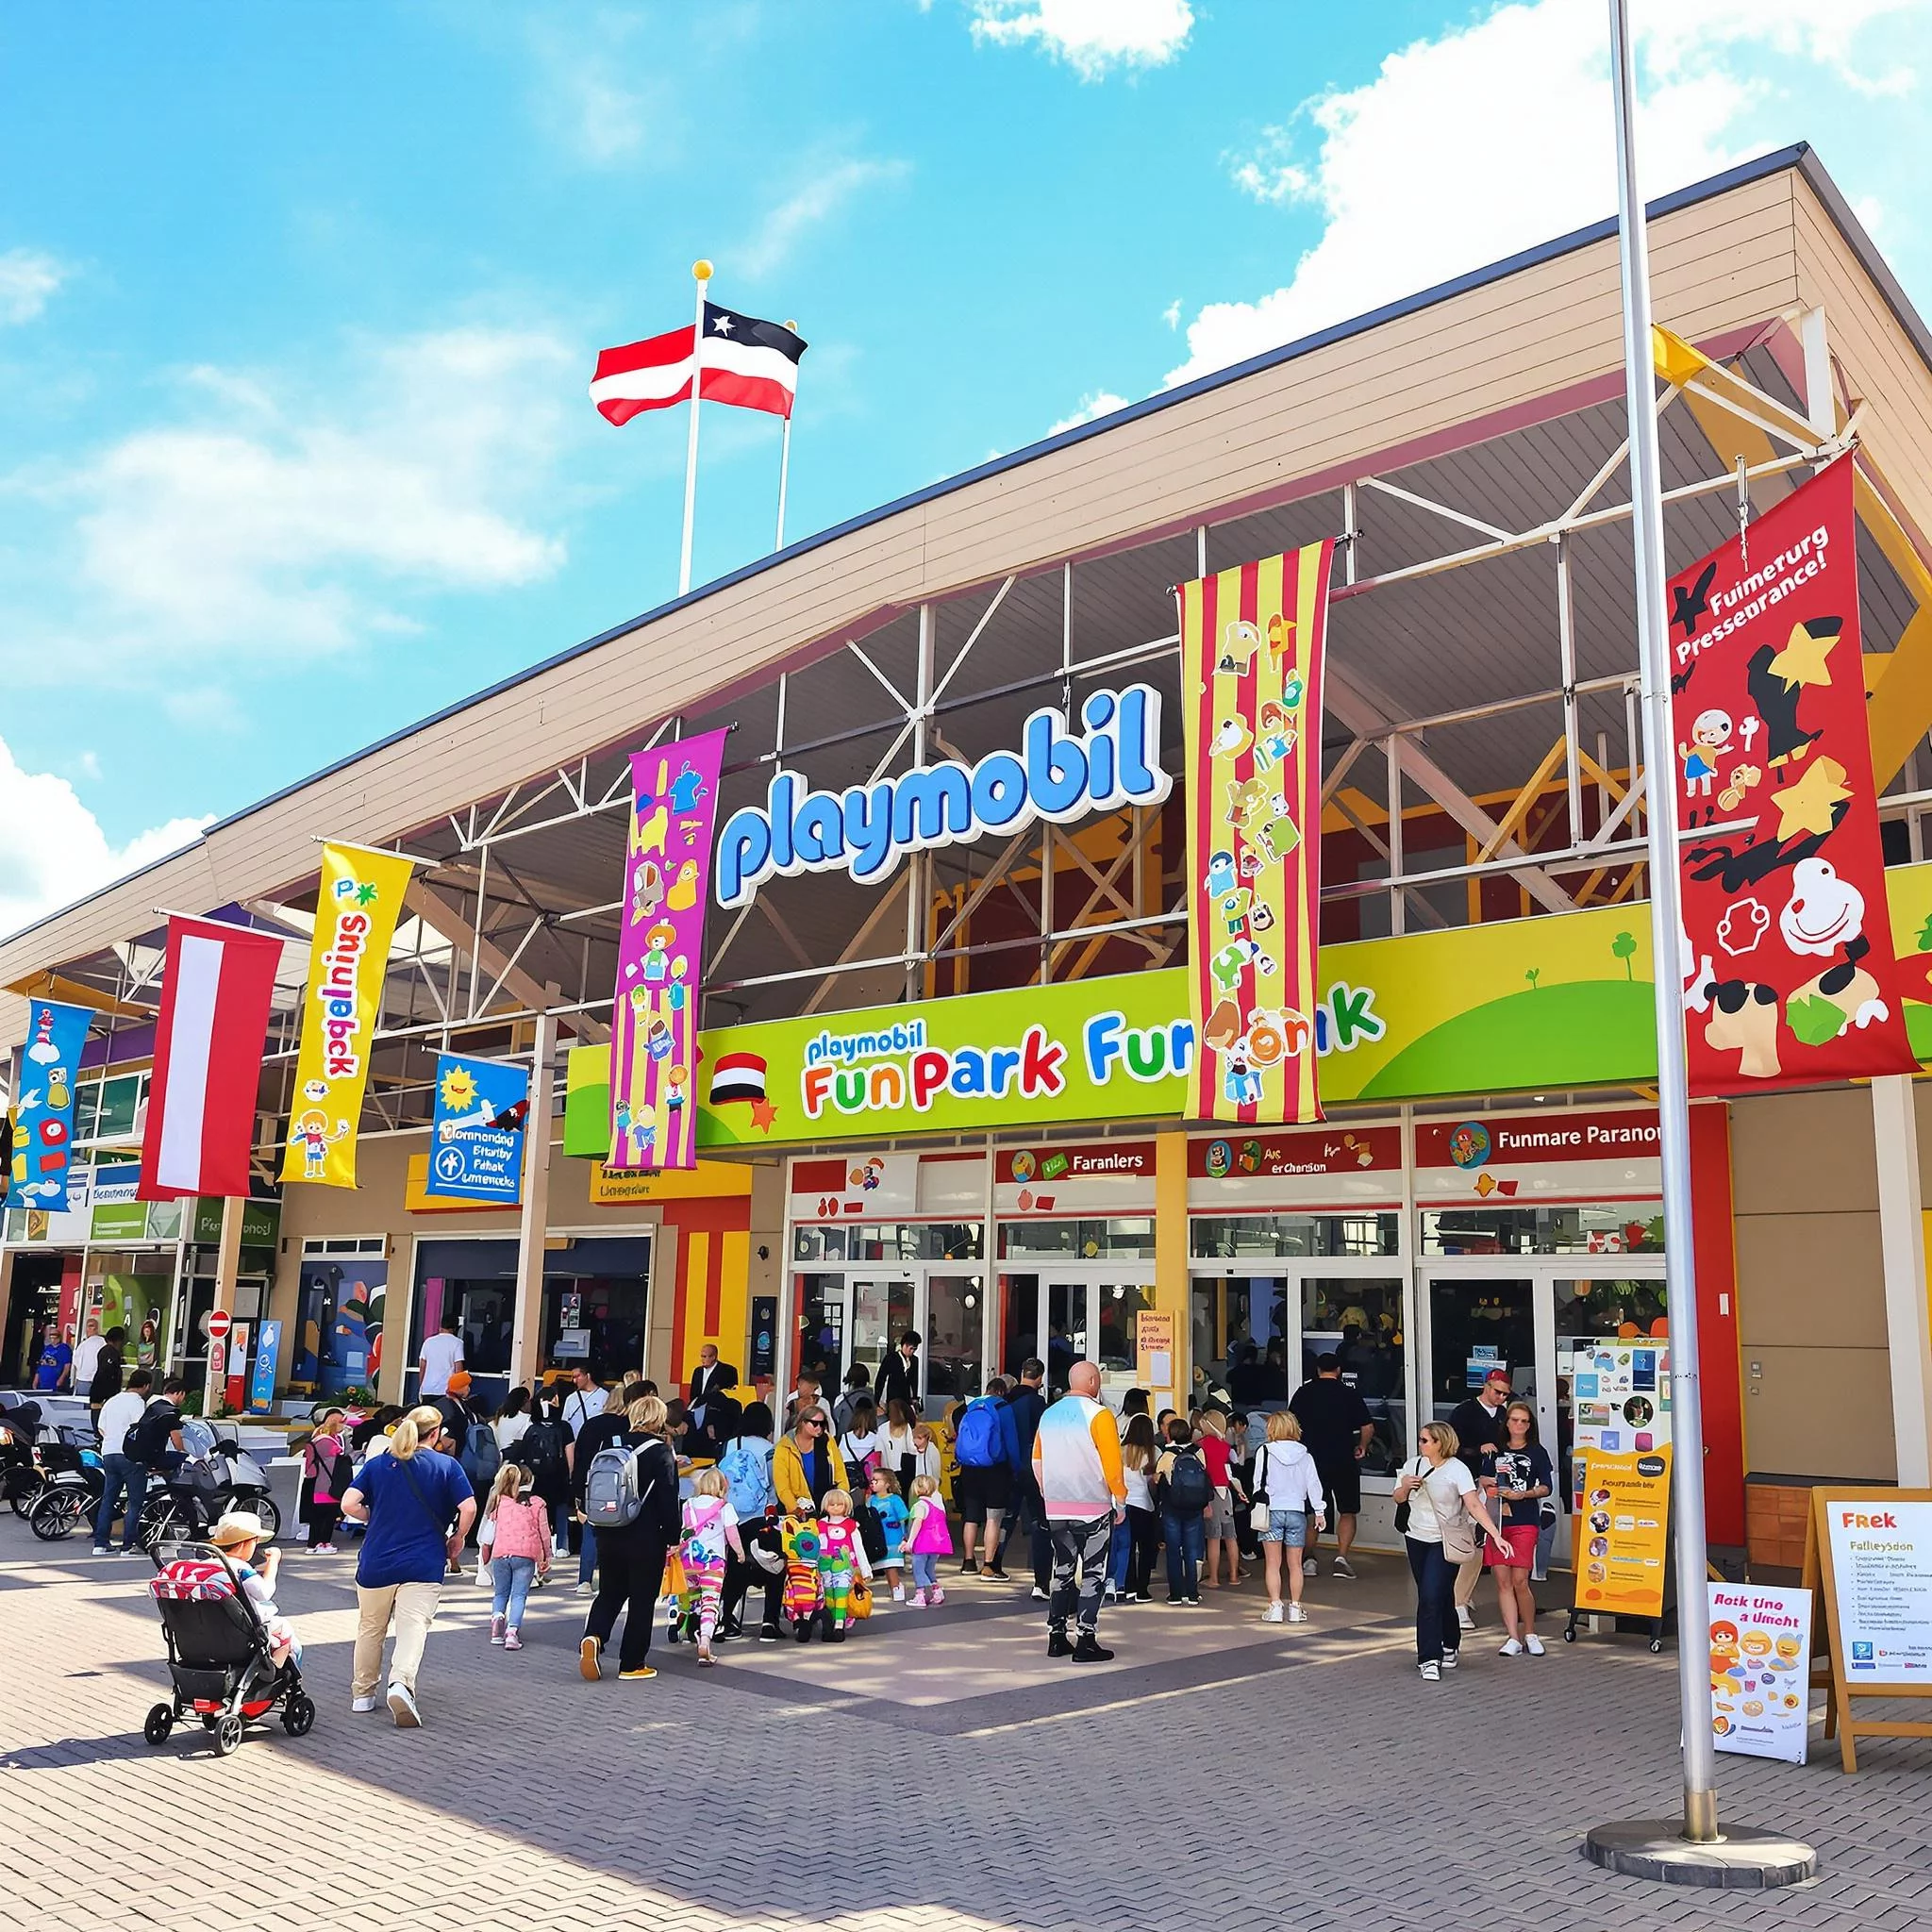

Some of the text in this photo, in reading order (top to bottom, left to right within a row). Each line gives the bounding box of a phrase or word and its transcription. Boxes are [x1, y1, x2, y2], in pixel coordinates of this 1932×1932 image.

[719, 686, 1158, 903] playmobil
[808, 1022, 923, 1066] playmobil
[806, 1067, 901, 1114] Fun
[1499, 1131, 1581, 1148] Funmare
